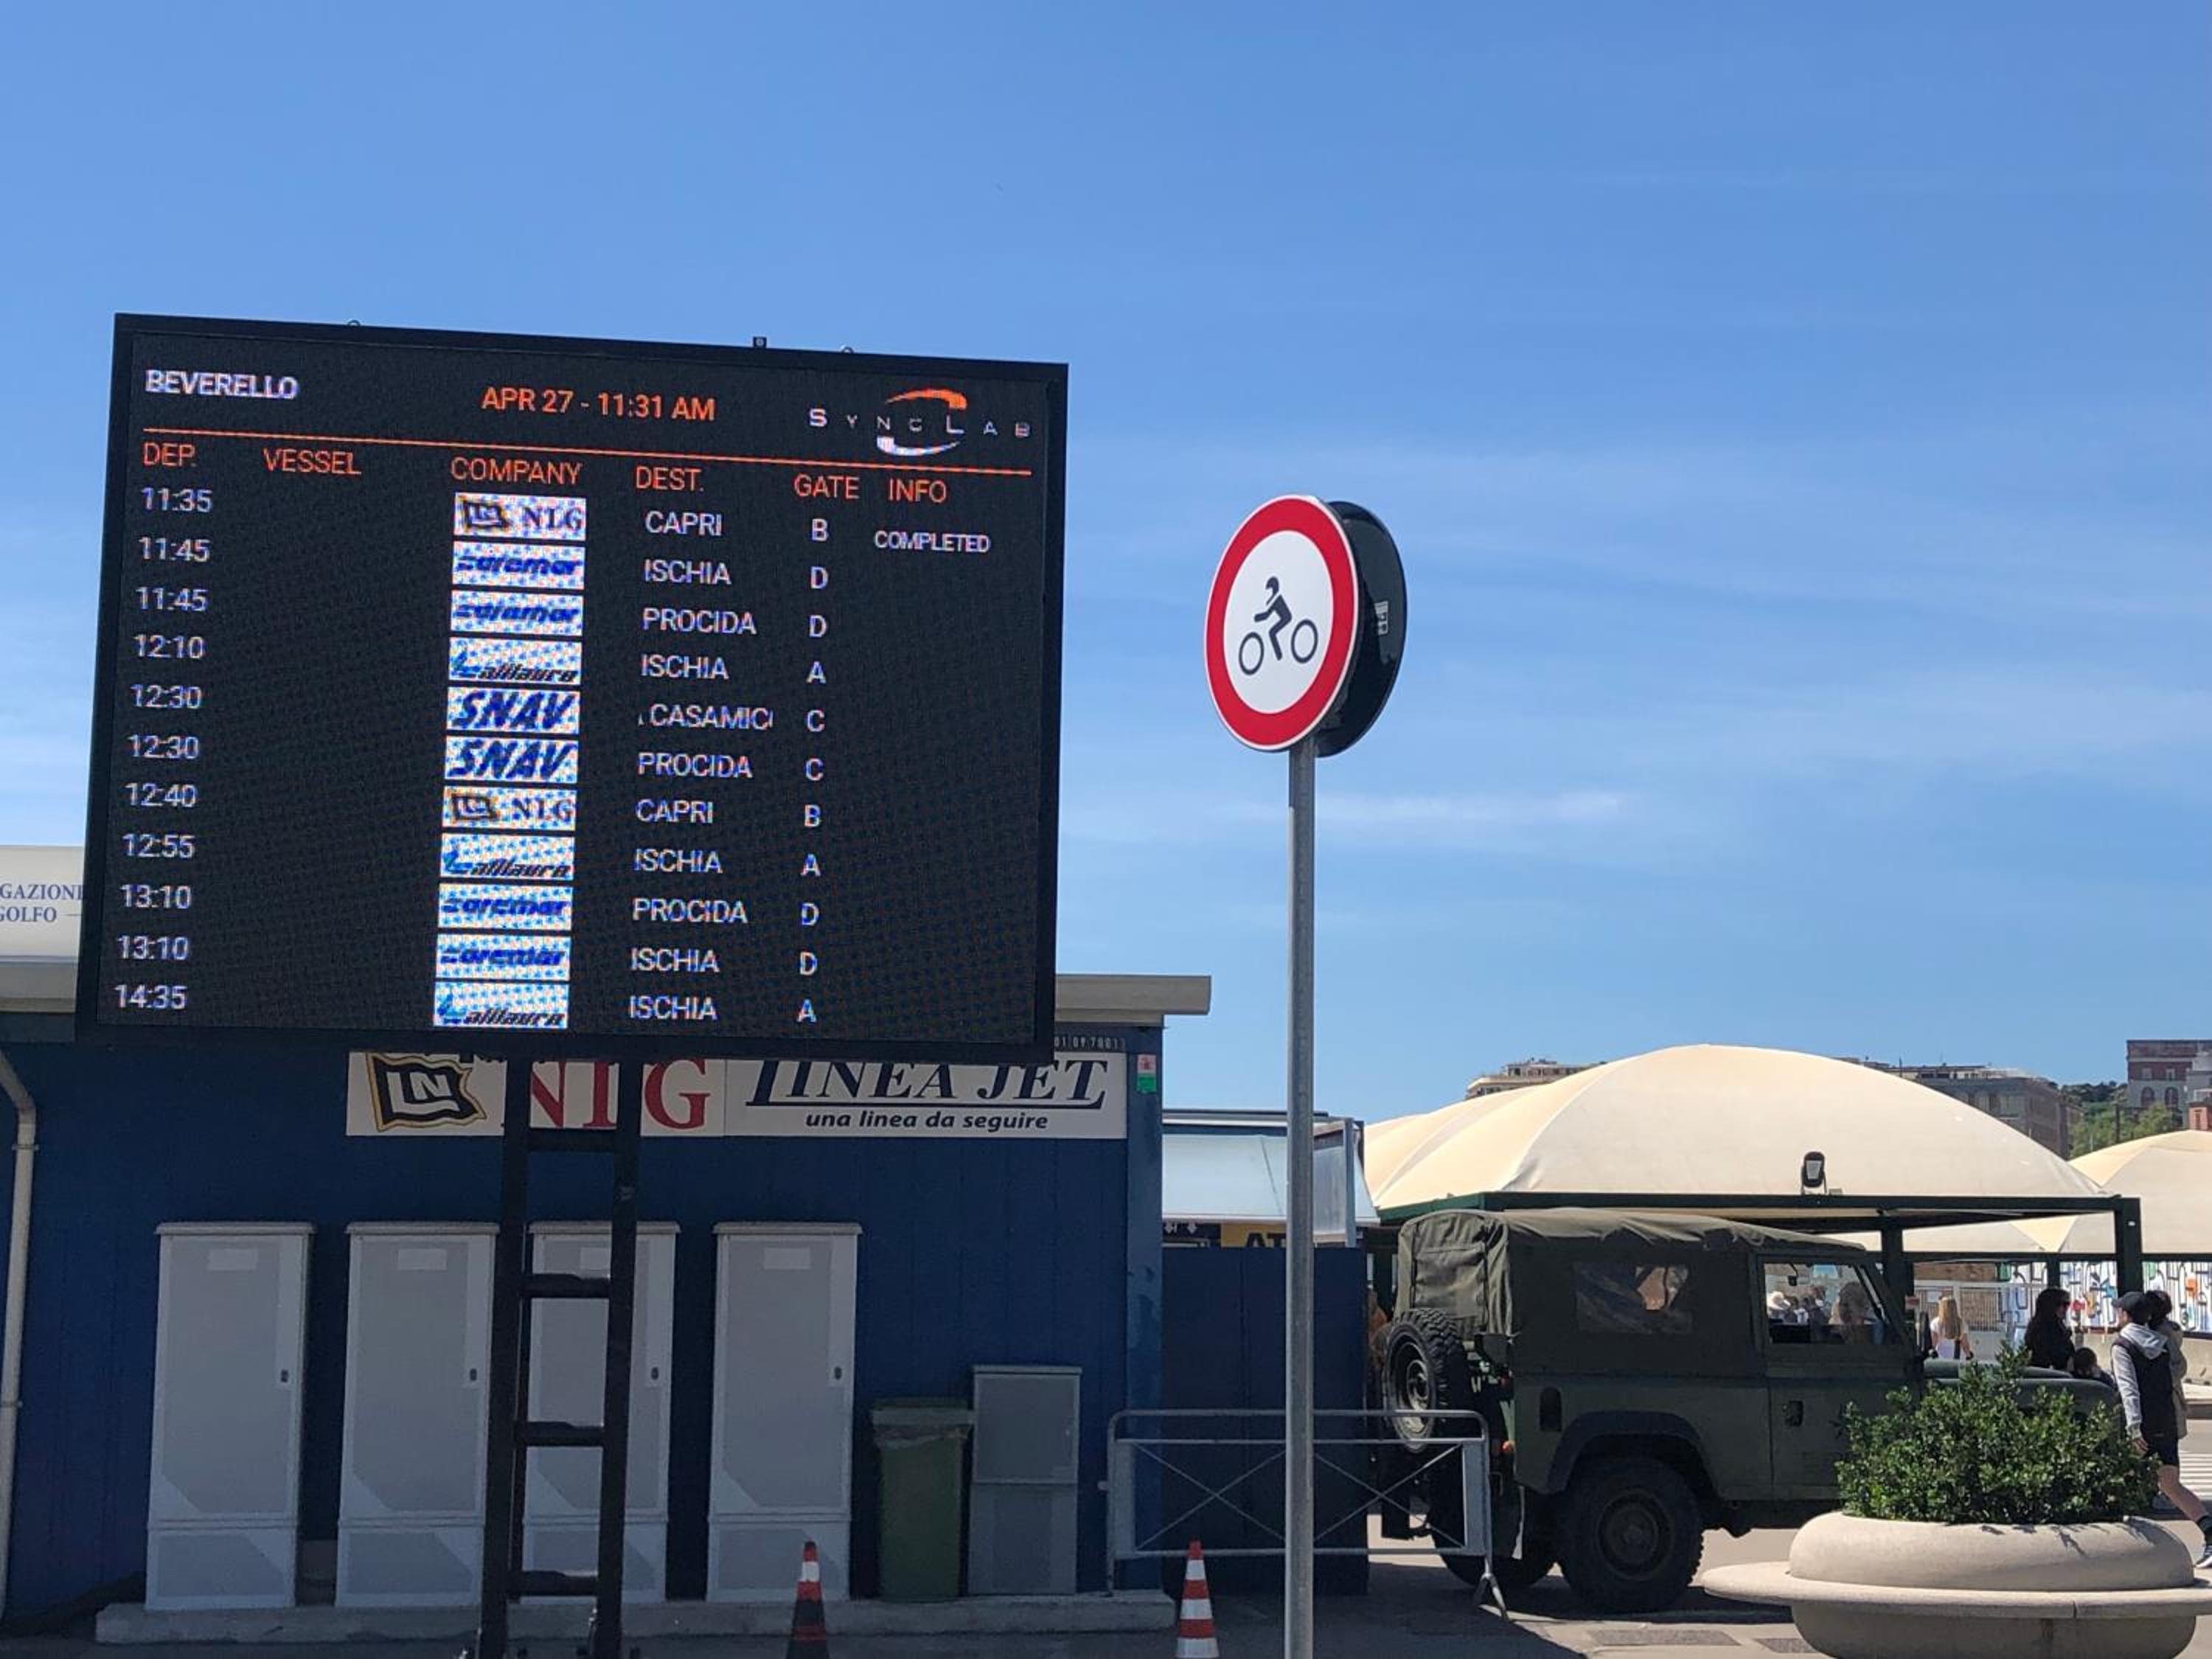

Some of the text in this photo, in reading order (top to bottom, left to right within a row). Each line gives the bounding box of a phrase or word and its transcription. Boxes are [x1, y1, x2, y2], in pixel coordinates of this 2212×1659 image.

[145, 369, 299, 401] BEVERELLO
[481, 387, 535, 411] APR
[542, 389, 573, 413] 27
[598, 393, 661, 417] 11:31
[672, 397, 715, 420] AM
[143, 443, 947, 503] DEP. VESSEL COMPANY DEST. GATE INFO
[142, 487, 212, 512] 11:35
[646, 511, 722, 535] CAPRI
[812, 519, 828, 541] B
[874, 531, 991, 553] COMPLETED
[139, 537, 210, 562] 11:45
[644, 560, 731, 584] ISCHIA
[811, 566, 828, 588] D
[136, 587, 208, 612] 11:45
[643, 608, 757, 634] PROCIDA
[810, 615, 827, 637] D
[133, 634, 204, 658] 12:10
[641, 655, 729, 679] ISCHIA
[807, 661, 826, 683] A
[131, 684, 201, 709] 12:30
[452, 690, 575, 728] SNAV
[807, 710, 825, 732] C
[128, 734, 824, 780] 12:30 SNAV PROCIDA C
[125, 783, 196, 807] 12:40
[636, 799, 713, 823] CAPRI
[804, 805, 821, 827] B
[122, 834, 195, 858] 12:55
[634, 849, 723, 873] ISCHIA
[801, 854, 820, 876] A
[120, 885, 191, 908] 13:10
[633, 898, 748, 923] PROCIDA
[801, 902, 818, 925] D
[117, 936, 189, 960] 13:10
[631, 948, 720, 973] ISCHIA
[799, 952, 817, 975] D
[115, 985, 187, 1009] 14:35
[630, 995, 717, 1020] ISCHIA
[797, 999, 816, 1022] A
[977, 1060, 1107, 1101] JET
[806, 1110, 1048, 1133] una linea da seguire
